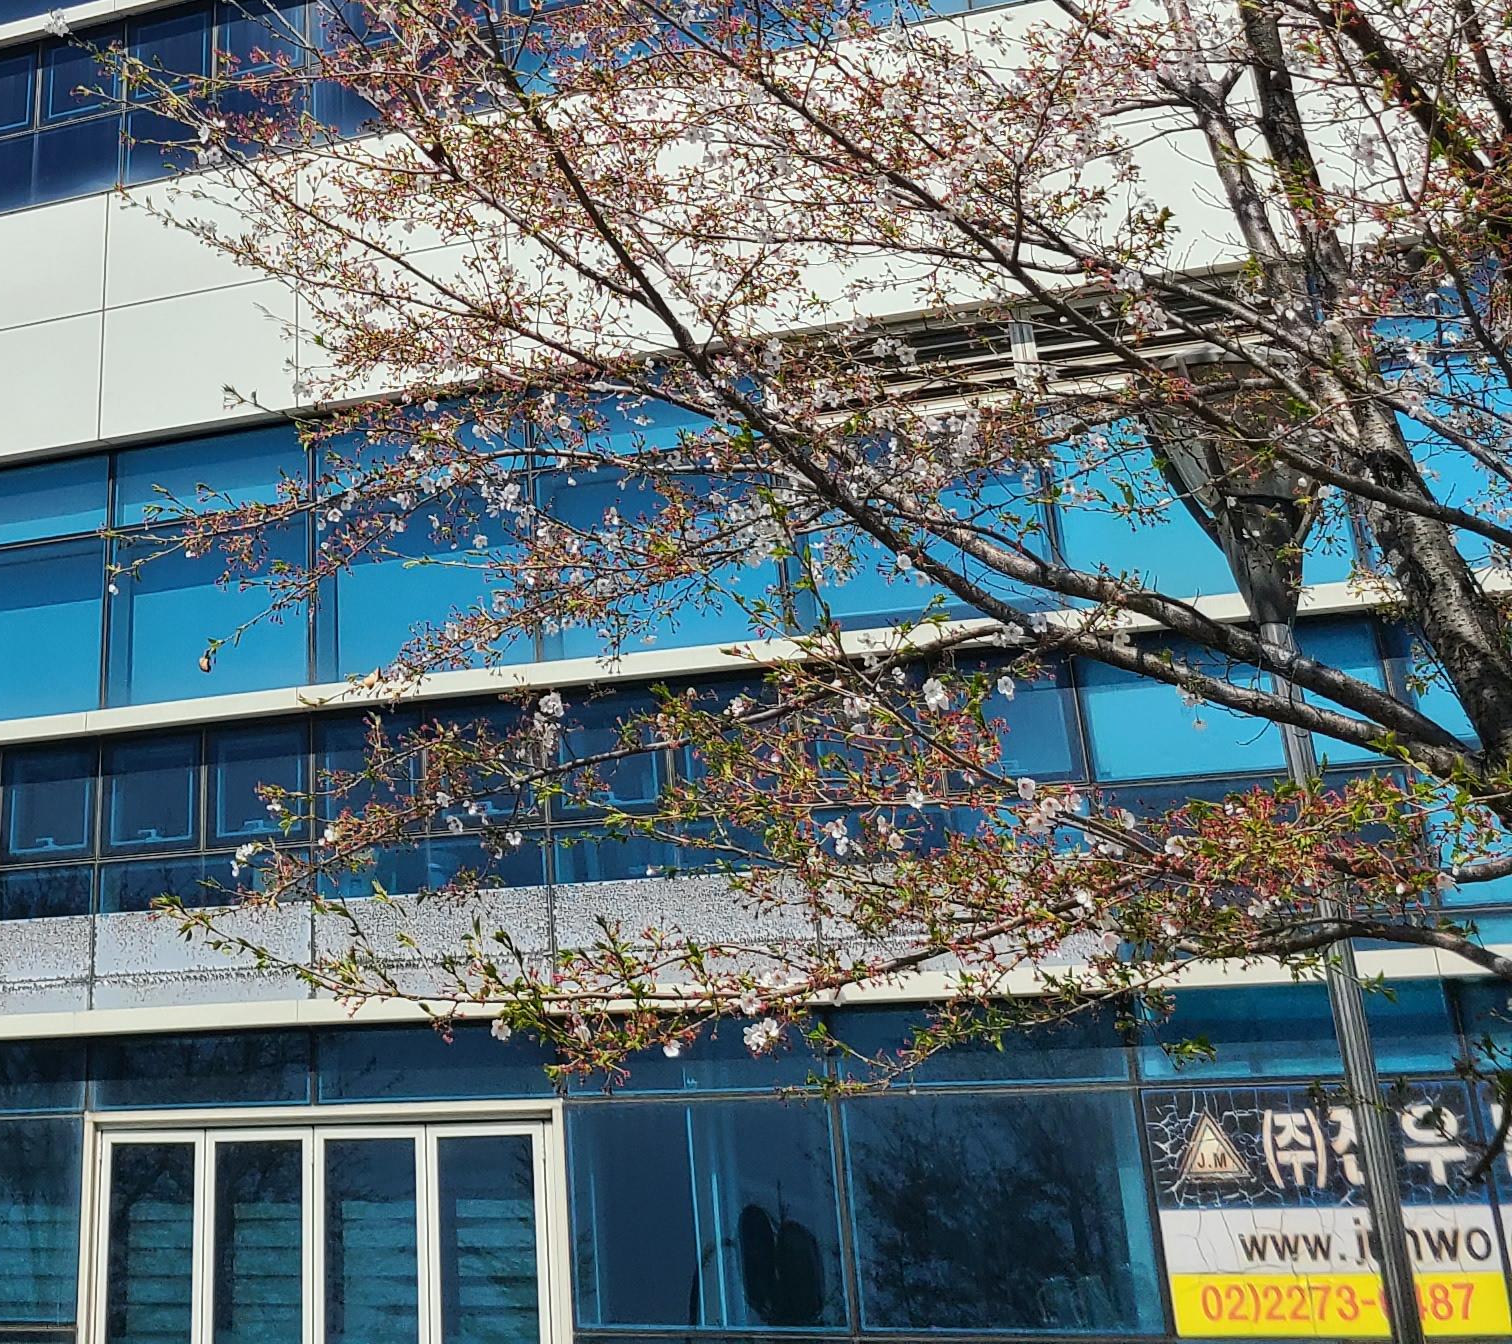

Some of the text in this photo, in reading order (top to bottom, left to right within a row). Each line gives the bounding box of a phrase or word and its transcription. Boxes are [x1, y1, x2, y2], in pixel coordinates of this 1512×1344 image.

[1196, 1154, 1228, 1171] J.M
[1262, 1104, 1512, 1190] (주)우
[1200, 1282, 1476, 1324] 02)2273-87
